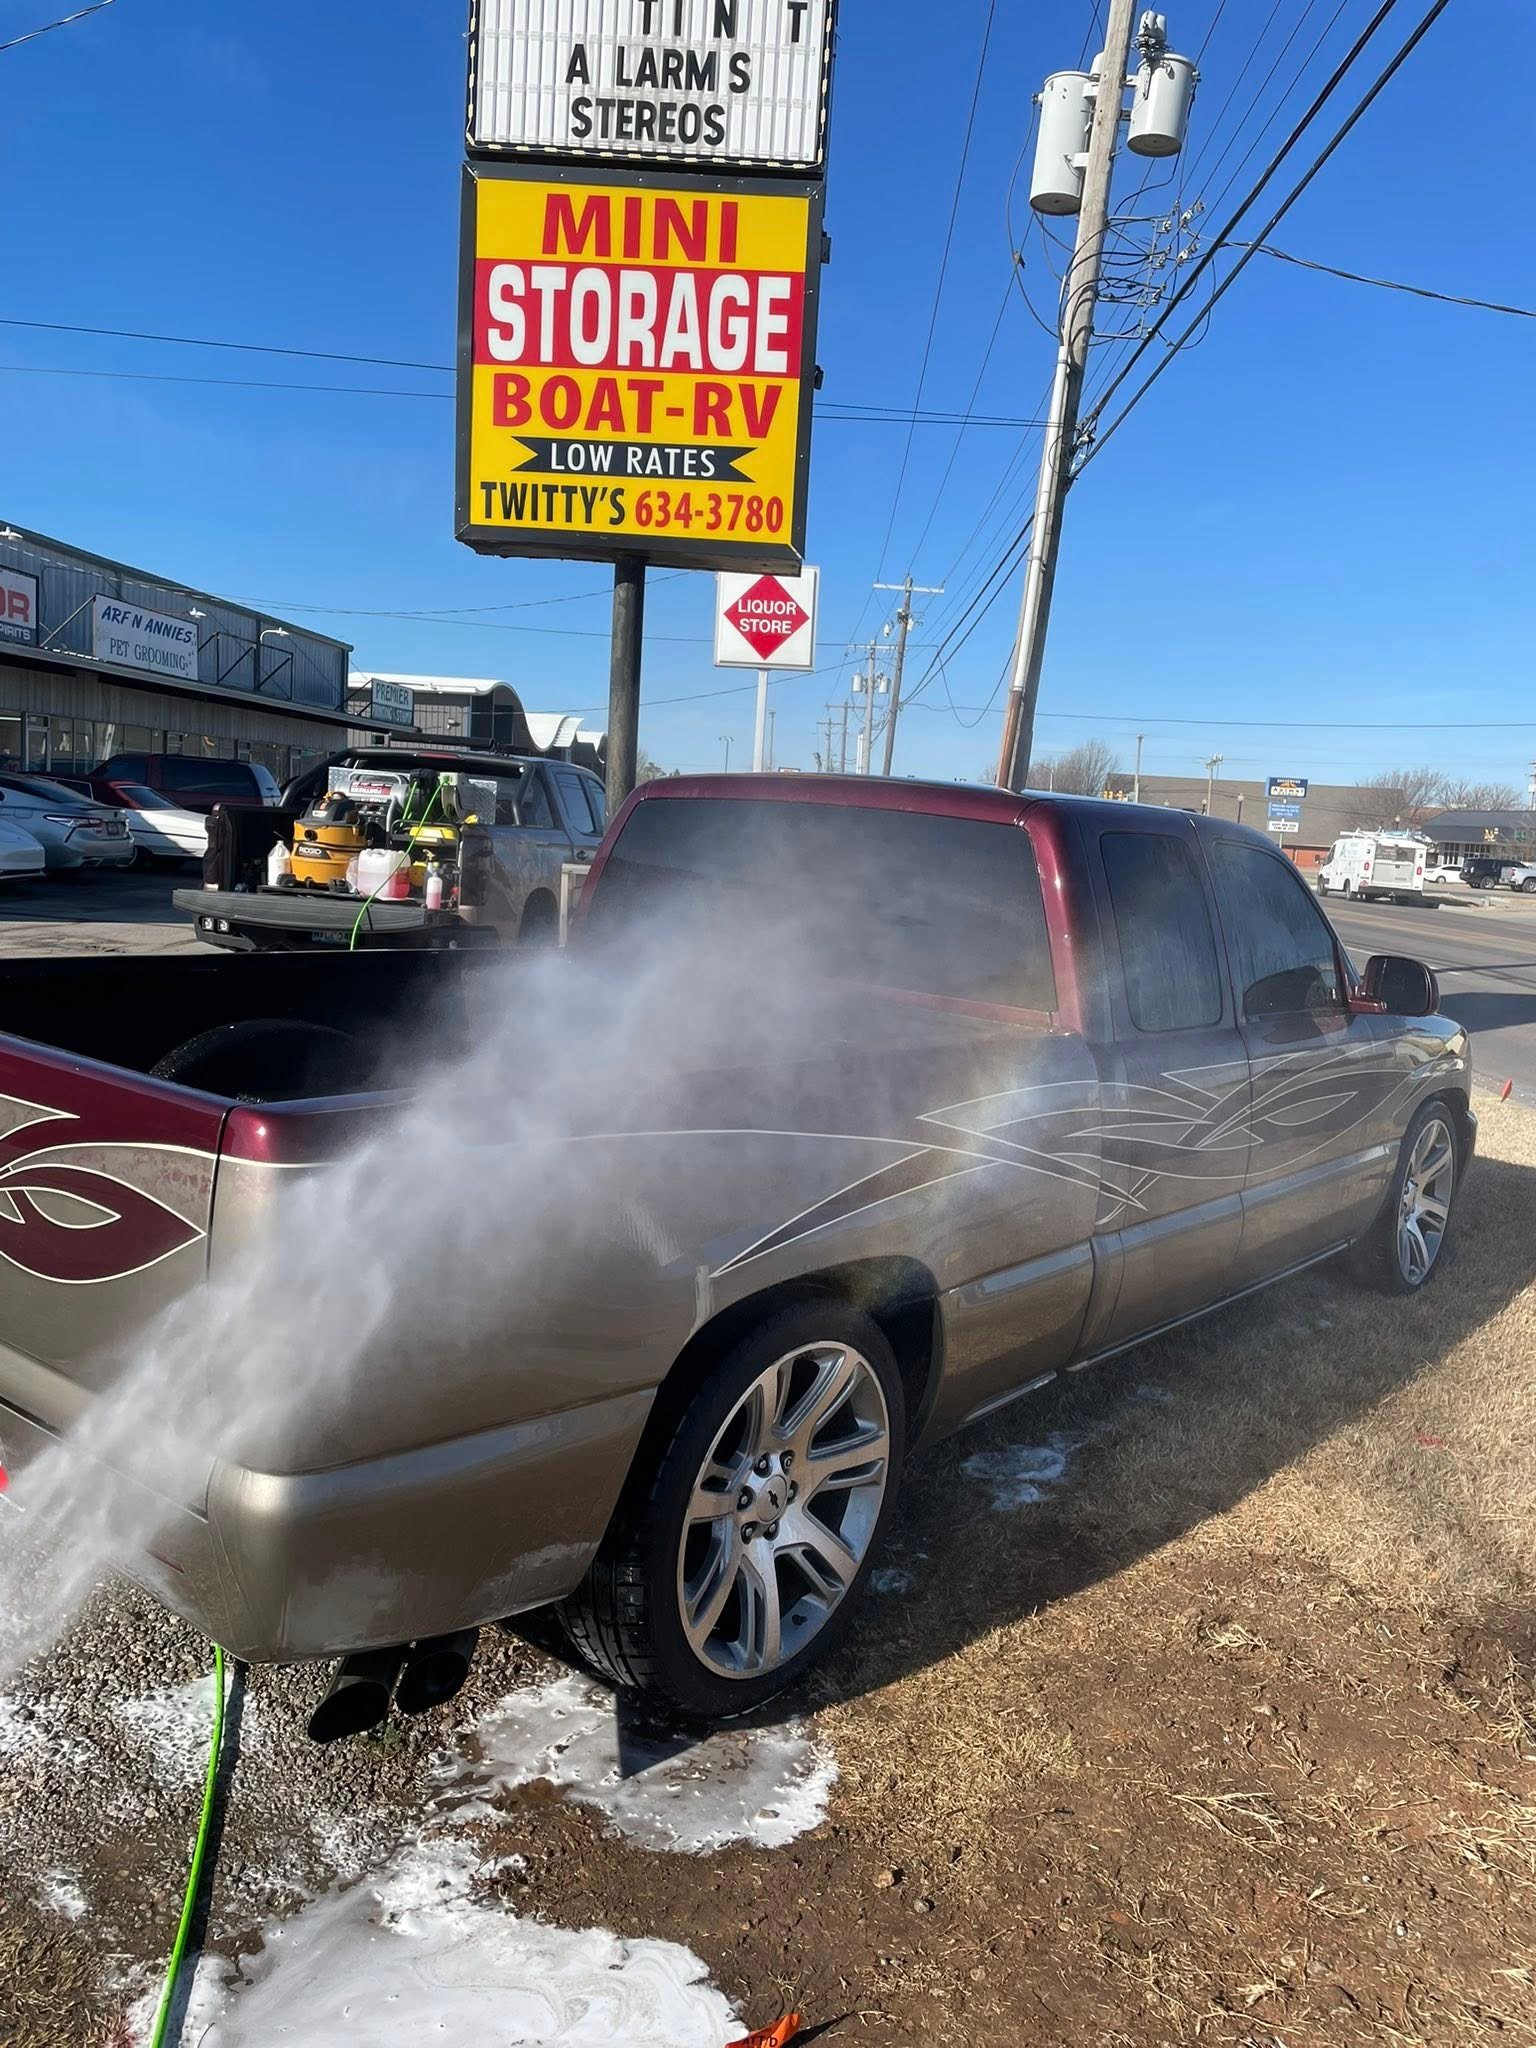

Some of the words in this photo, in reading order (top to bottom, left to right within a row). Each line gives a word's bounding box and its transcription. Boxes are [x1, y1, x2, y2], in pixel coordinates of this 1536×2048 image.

[570, 96, 726, 146] STEREOS
[541, 193, 739, 263] MINI
[487, 264, 791, 373] STORAGE
[492, 372, 783, 439] BOAT-RV
[550, 442, 613, 474] LOW
[626, 446, 716, 478] RATES
[480, 481, 626, 526] TWITTY'S
[635, 490, 784, 534] 634-3780
[101, 605, 132, 625] ARF
[131, 614, 143, 629] N
[144, 618, 193, 643] ANNIES
[737, 599, 797, 615] LIQUOR
[739, 618, 793, 634] STORE
[110, 637, 130, 657] PET
[134, 643, 186, 671] GROOMING
[375, 682, 409, 706] PREMIER
